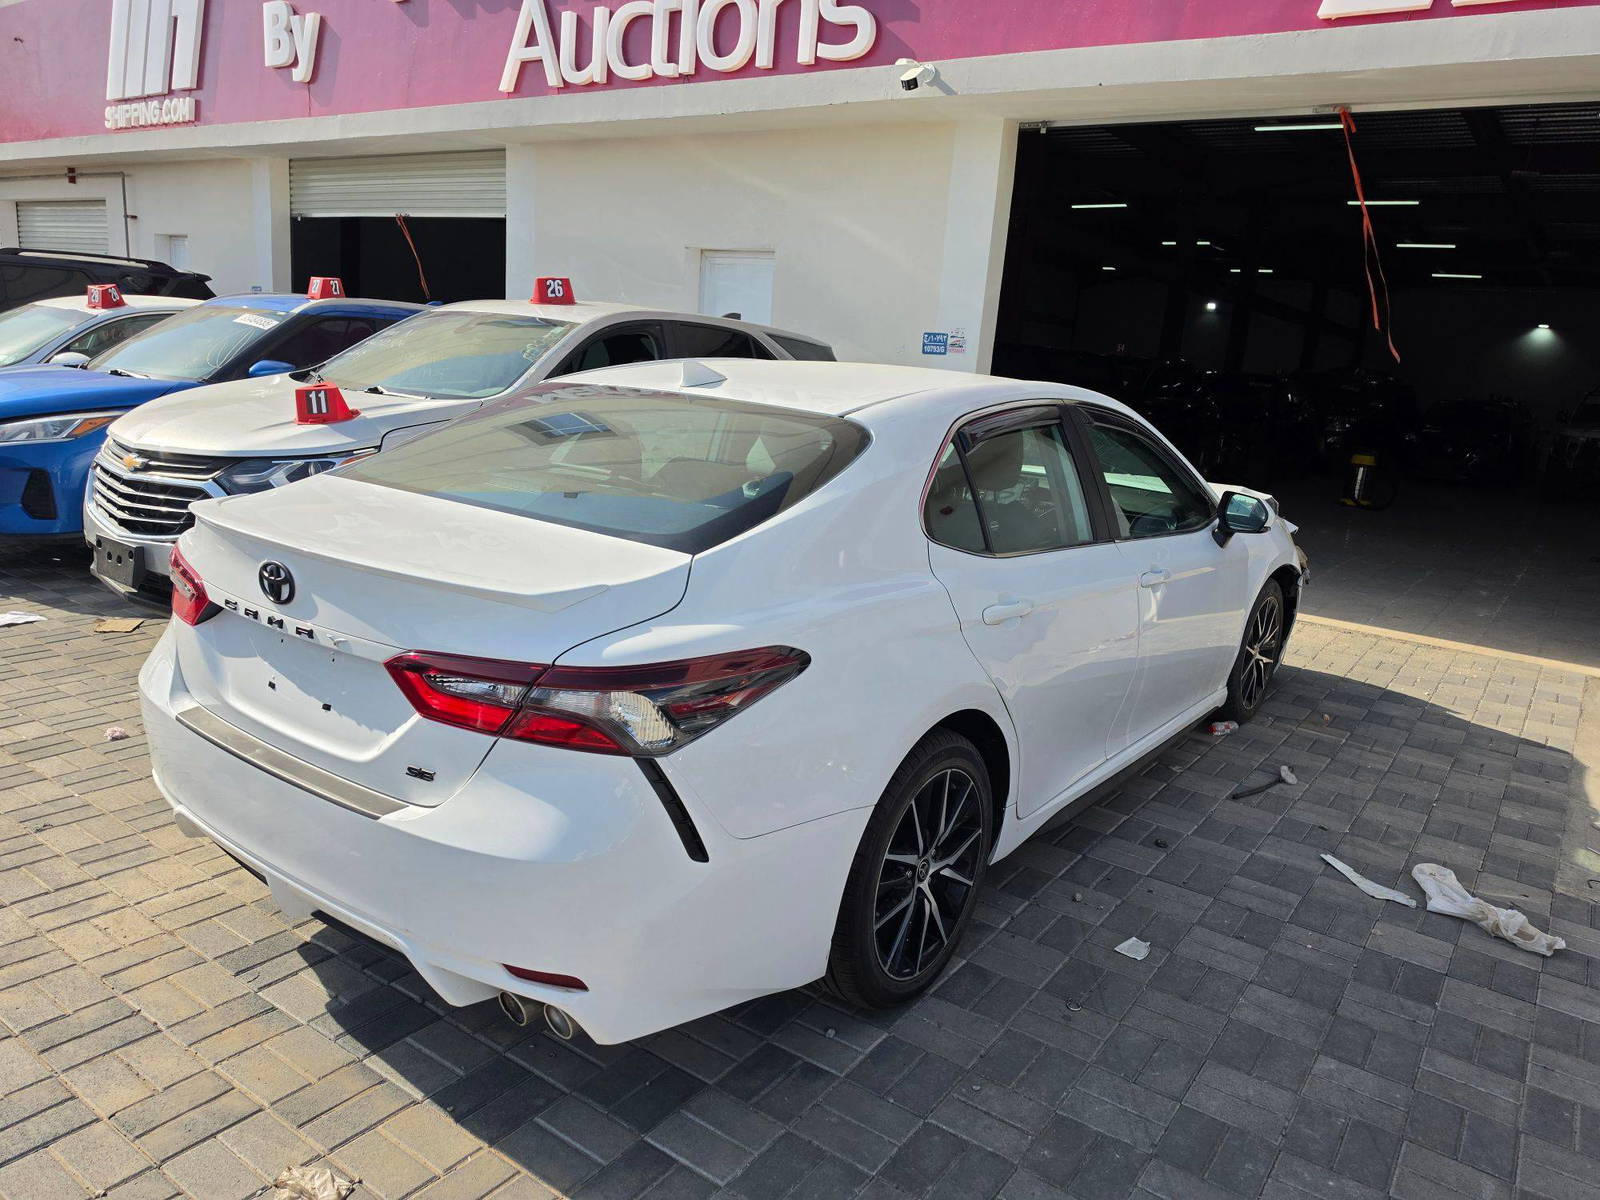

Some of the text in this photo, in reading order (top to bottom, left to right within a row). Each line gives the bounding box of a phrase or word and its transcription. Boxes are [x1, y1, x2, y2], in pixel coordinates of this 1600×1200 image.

[263, 0, 876, 93] By Auctions
[547, 280, 564, 297] 26
[309, 390, 327, 414] 11
[405, 766, 436, 782] SE
